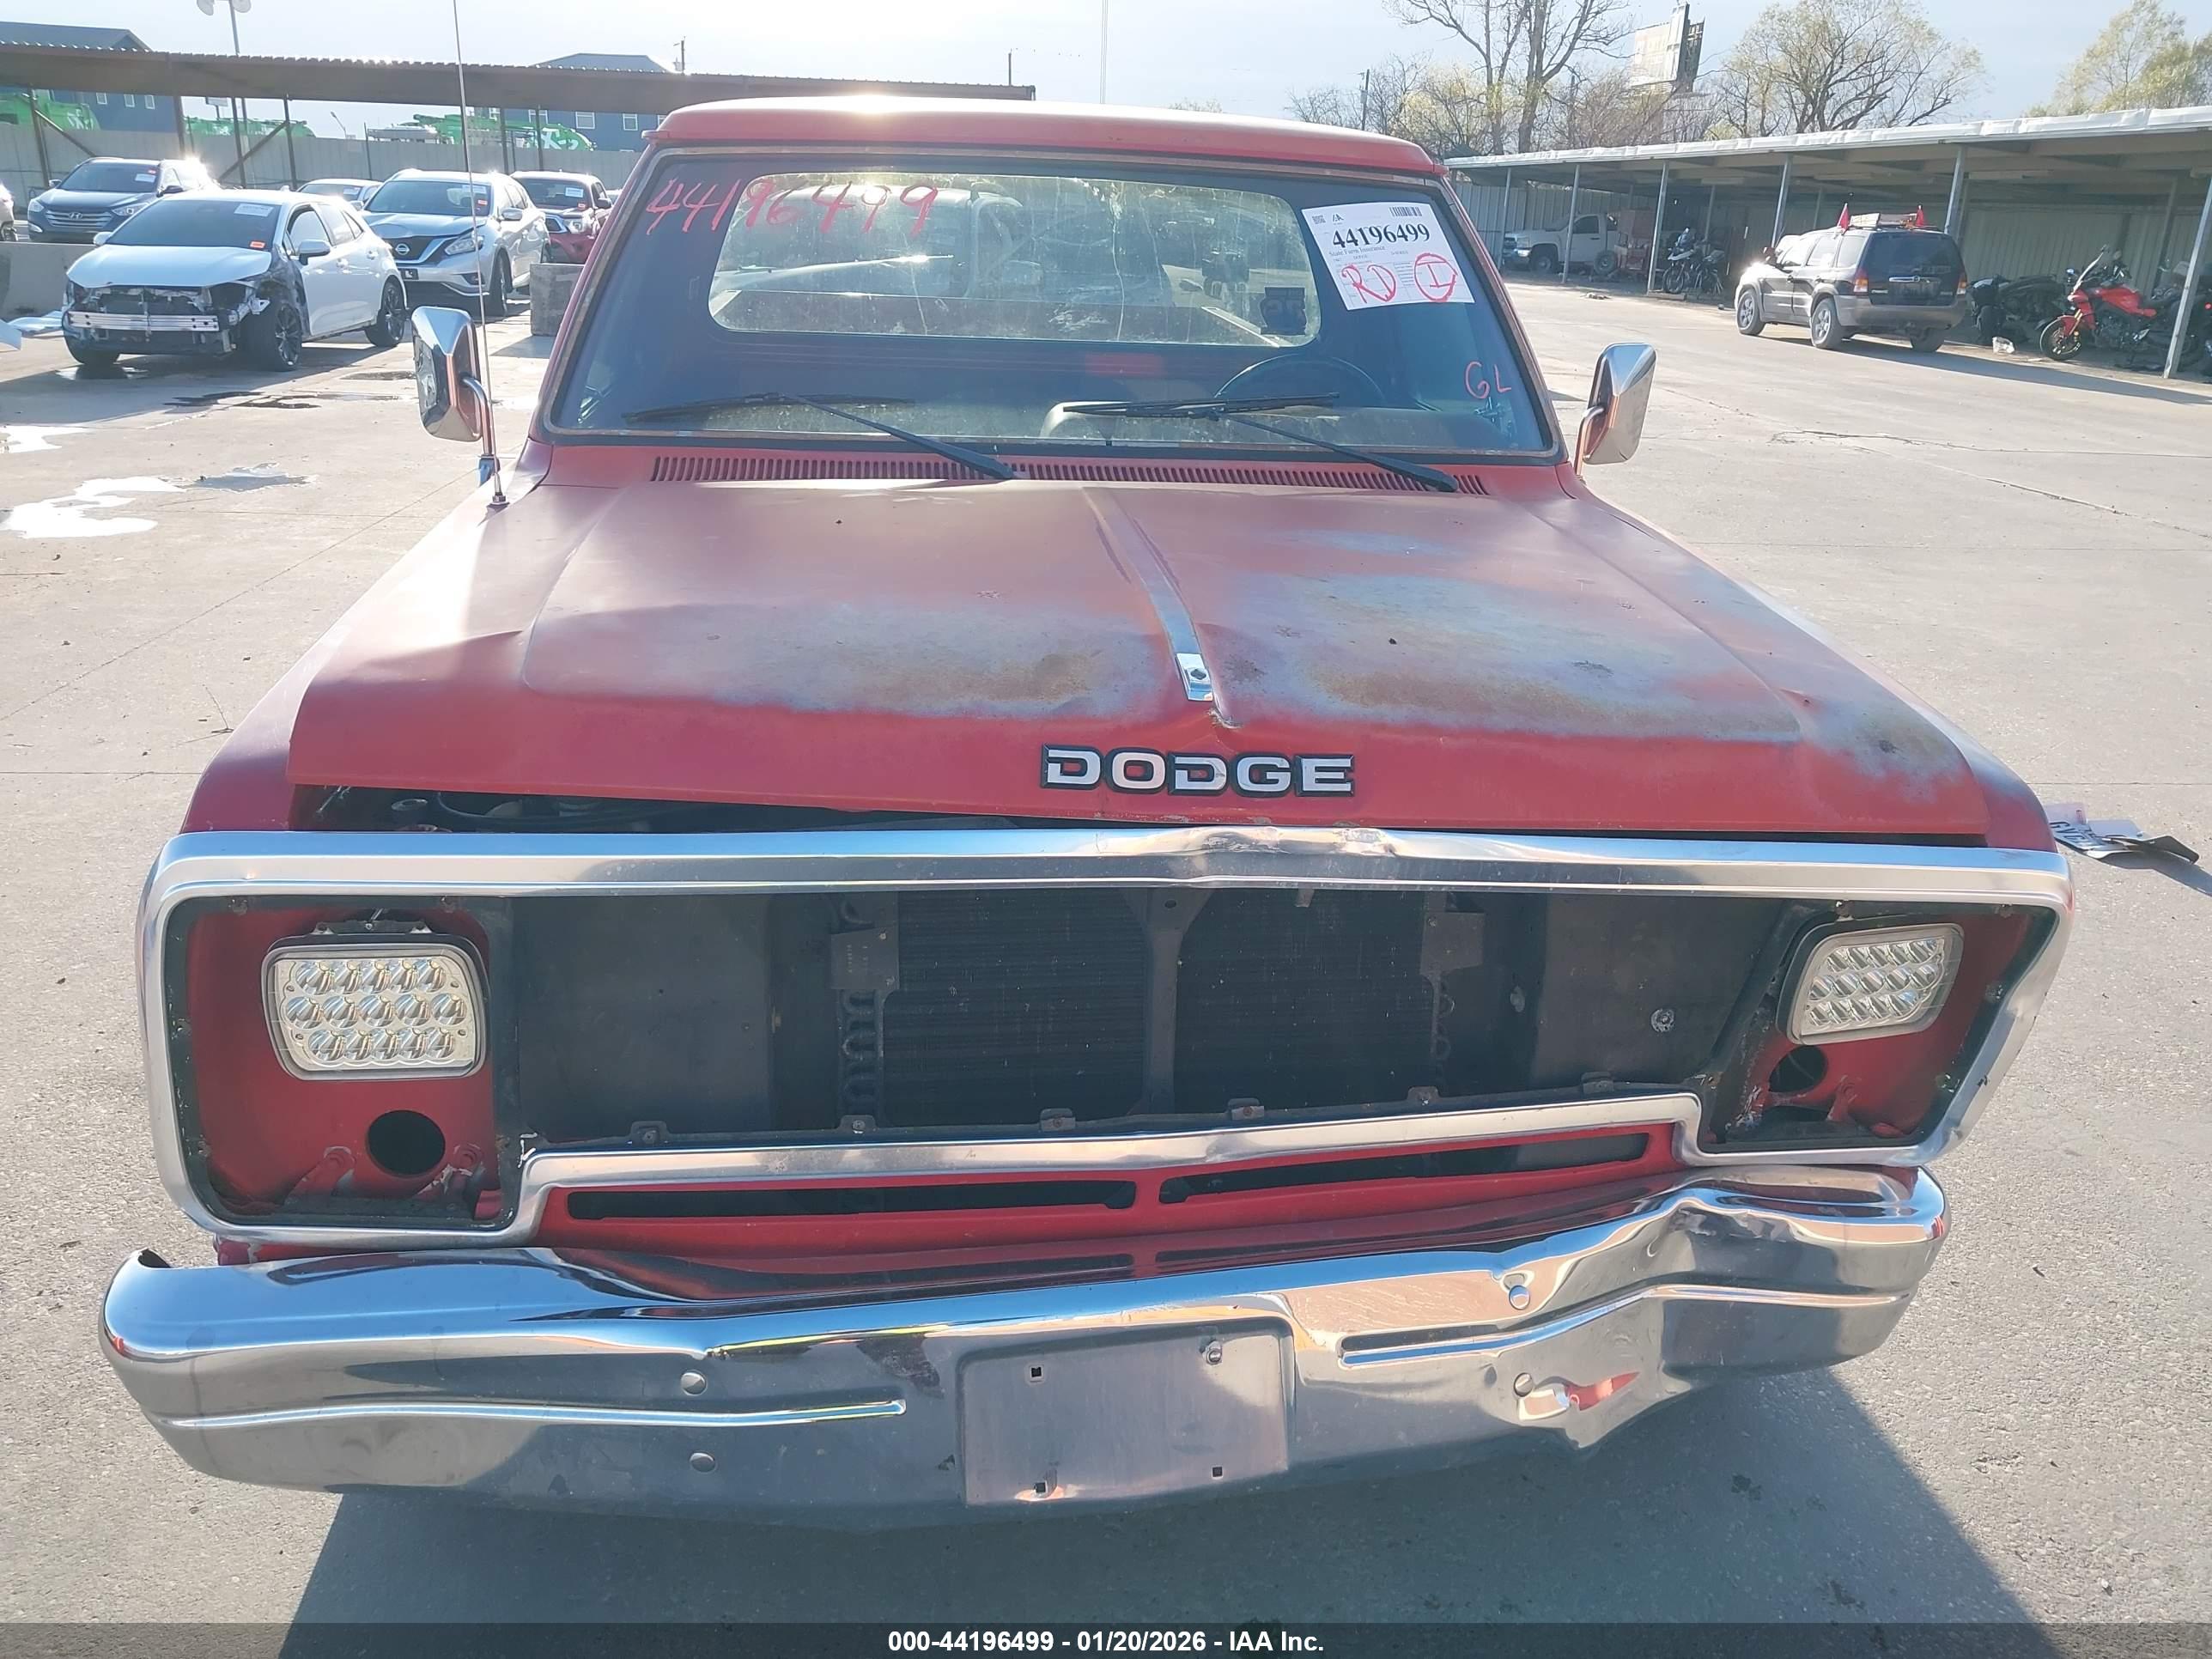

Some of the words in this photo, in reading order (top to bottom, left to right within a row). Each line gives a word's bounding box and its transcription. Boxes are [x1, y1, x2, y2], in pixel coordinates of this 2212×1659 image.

[646, 177, 939, 237] 44196499
[1333, 224, 1431, 248] 44196499
[1464, 361, 1512, 399] GL
[1042, 744, 1354, 797] DODGE
